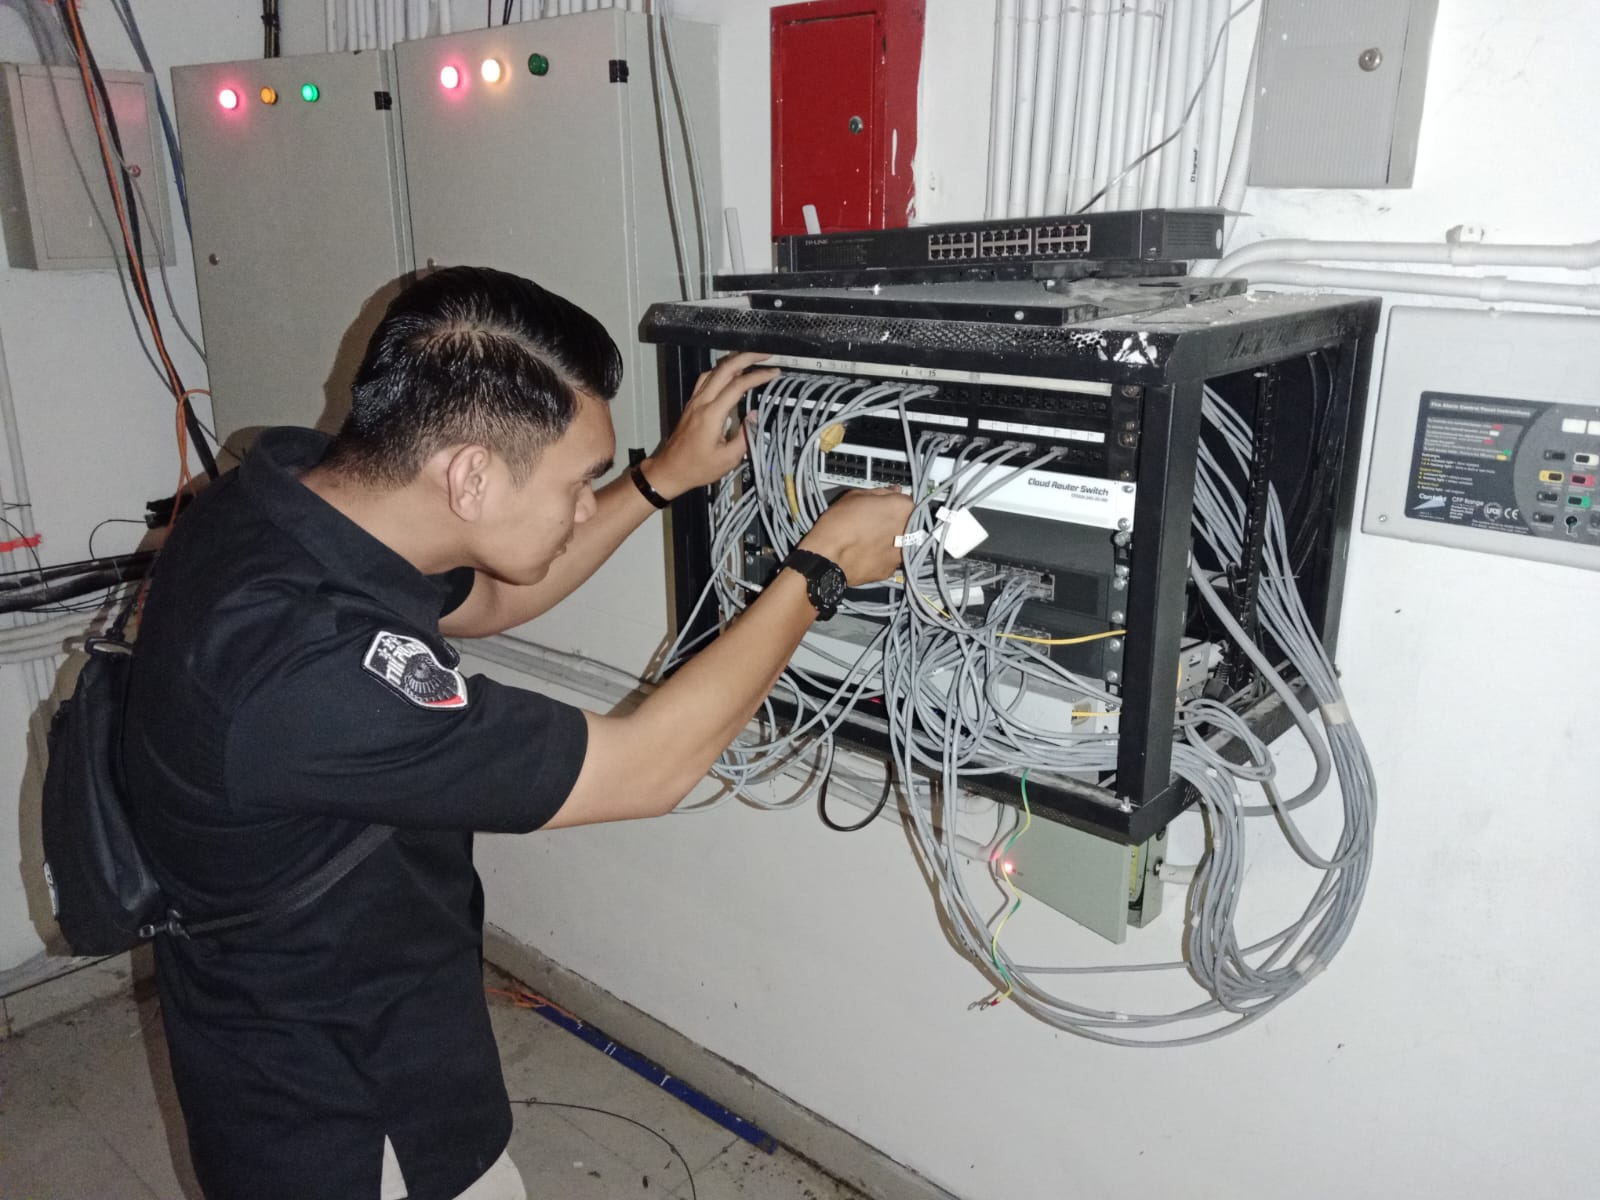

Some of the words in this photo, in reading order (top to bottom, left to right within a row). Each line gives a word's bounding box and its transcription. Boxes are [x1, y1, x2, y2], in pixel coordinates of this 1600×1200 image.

[1027, 477, 1050, 488] Cloud
[1051, 481, 1079, 492] Router
[1080, 485, 1109, 496] Switch
